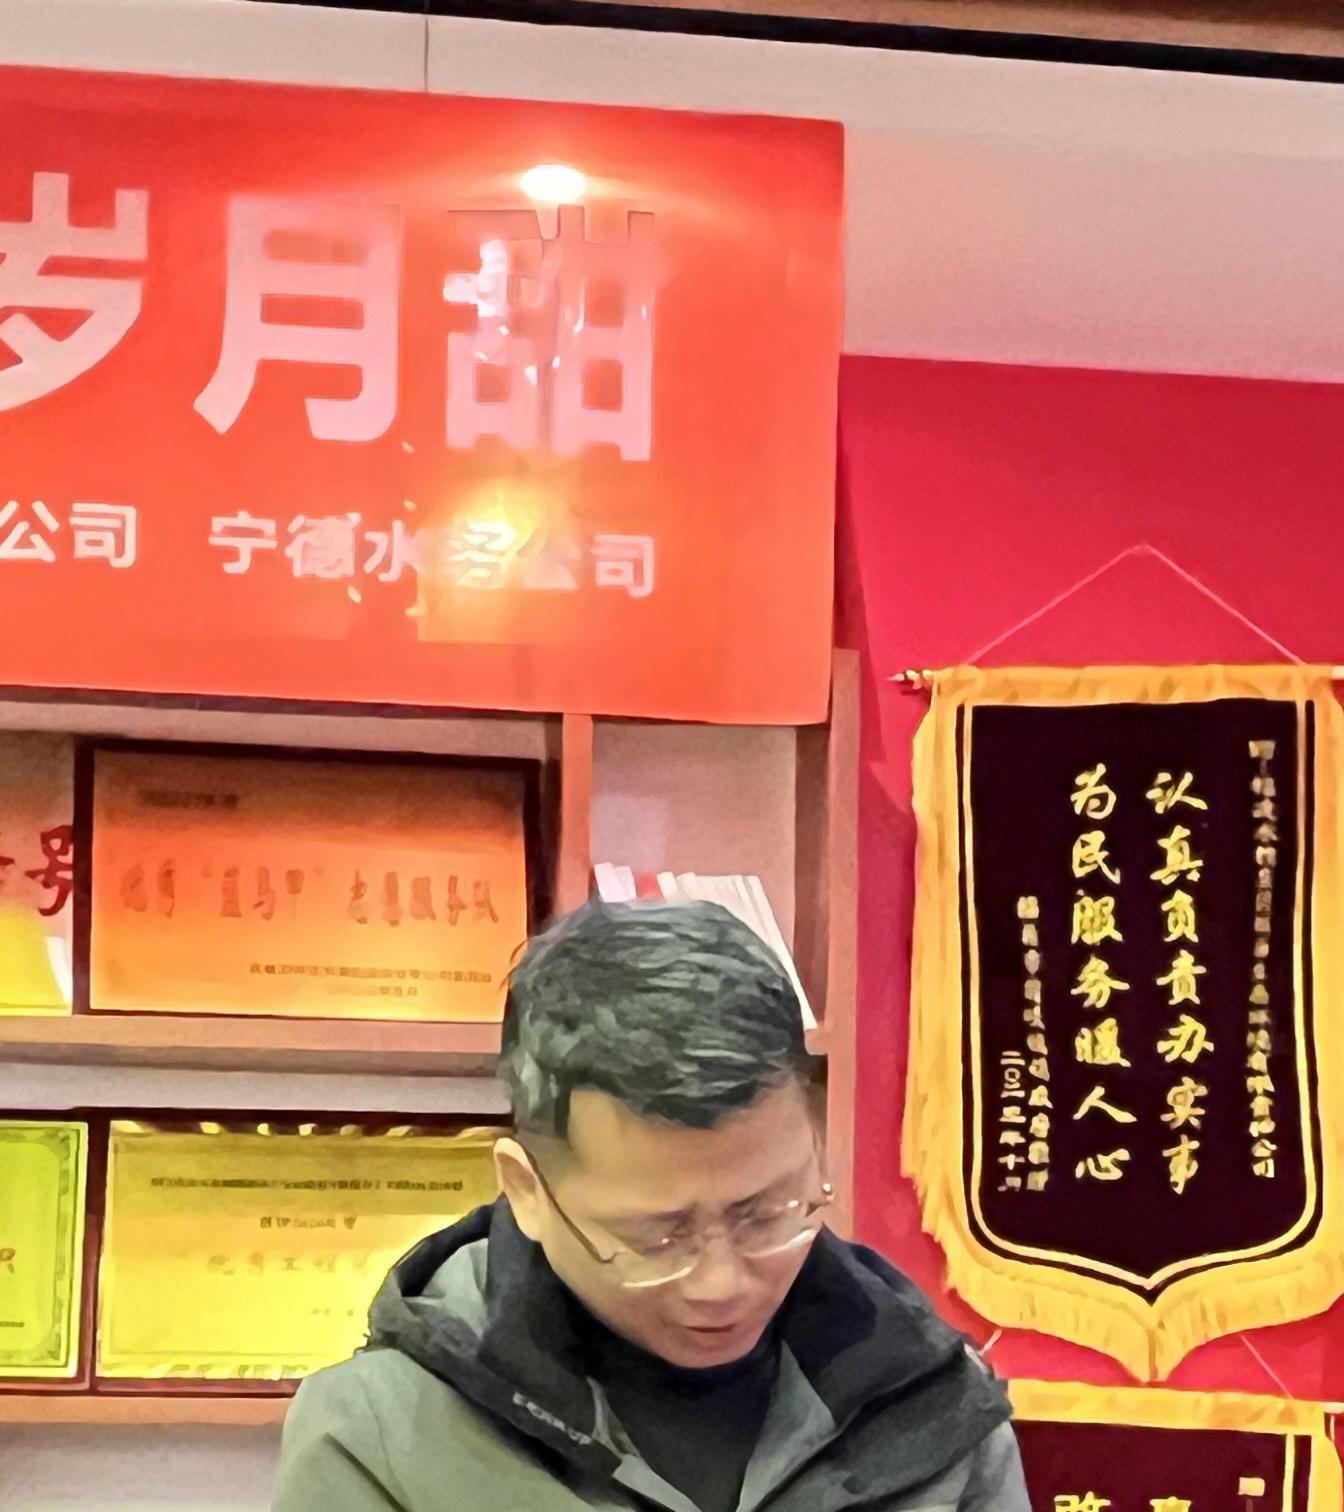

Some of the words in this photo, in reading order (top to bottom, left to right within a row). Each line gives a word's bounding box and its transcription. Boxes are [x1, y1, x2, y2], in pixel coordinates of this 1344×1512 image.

[1069, 762, 1138, 1182] 为民服务暖人心
[1145, 770, 1214, 1195] 认真负责办实事
